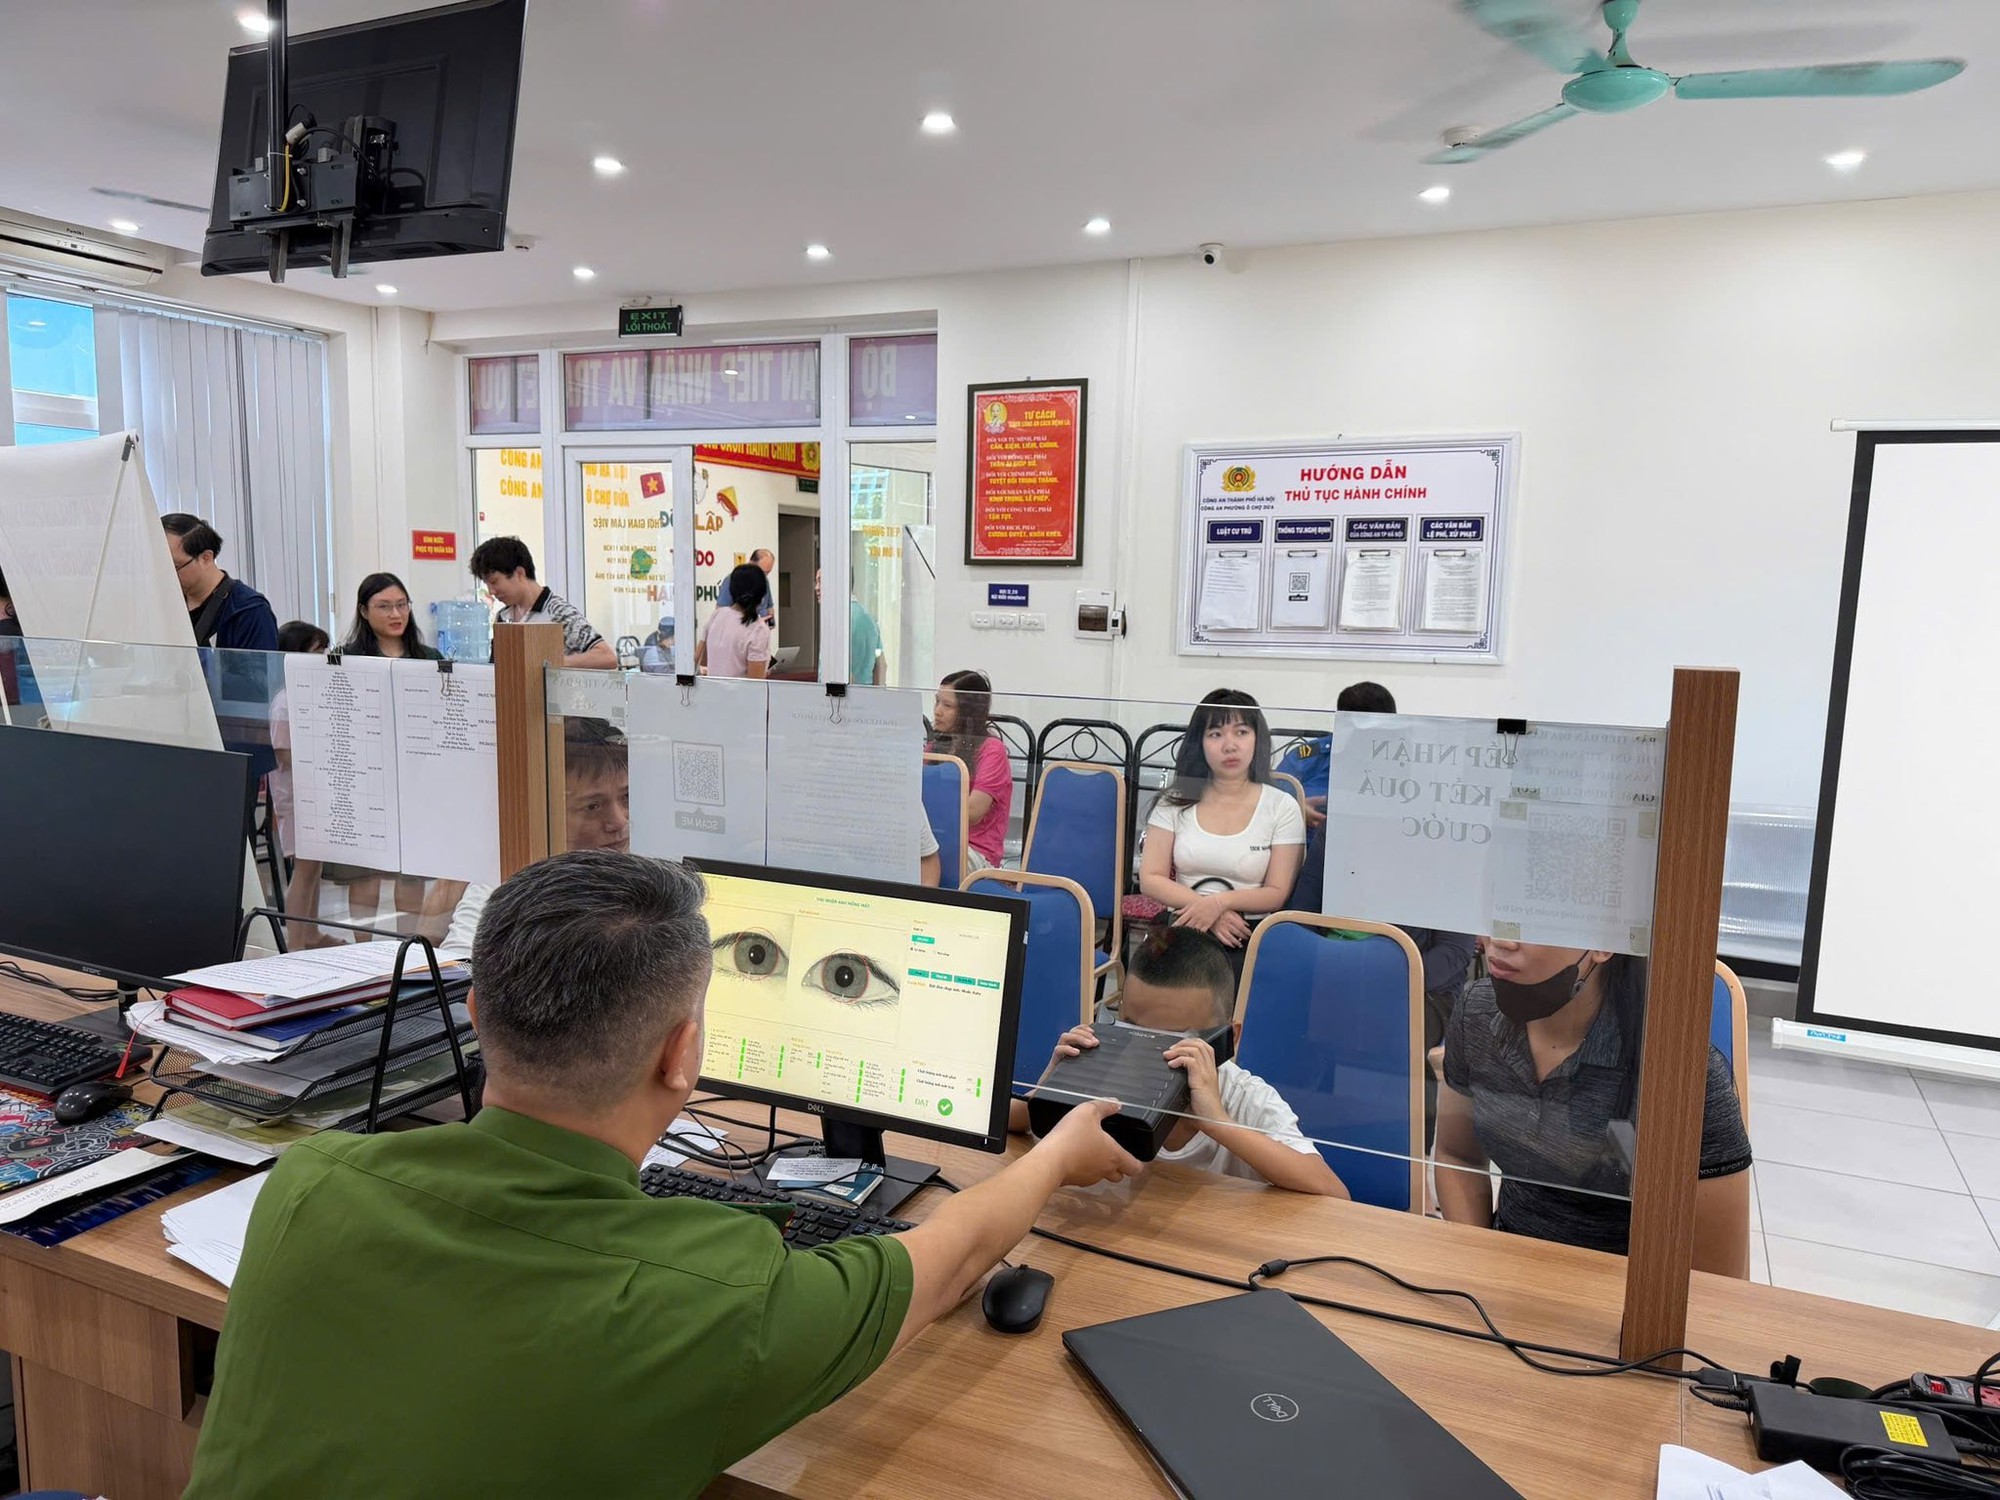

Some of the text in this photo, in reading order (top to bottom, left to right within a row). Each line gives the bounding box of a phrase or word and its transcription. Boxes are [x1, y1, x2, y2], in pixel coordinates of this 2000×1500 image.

[630, 312, 668, 320] EXIT
[626, 320, 672, 332] LỐI THOÁT
[1036, 410, 1056, 419] CÁCH
[1300, 459, 1407, 482] HƯỚNG DẪN
[501, 476, 527, 498] CÔNG
[1285, 485, 1427, 503] THỦ TỤC HÀNH CHÍNH
[695, 511, 723, 535] LẬP
[1353, 521, 1368, 530] CÁC
[1430, 521, 1444, 530] CÁC
[696, 579, 721, 601] PHÚ
[808, 1103, 825, 1113] DELL
[1262, 1396, 1289, 1418] DELL
